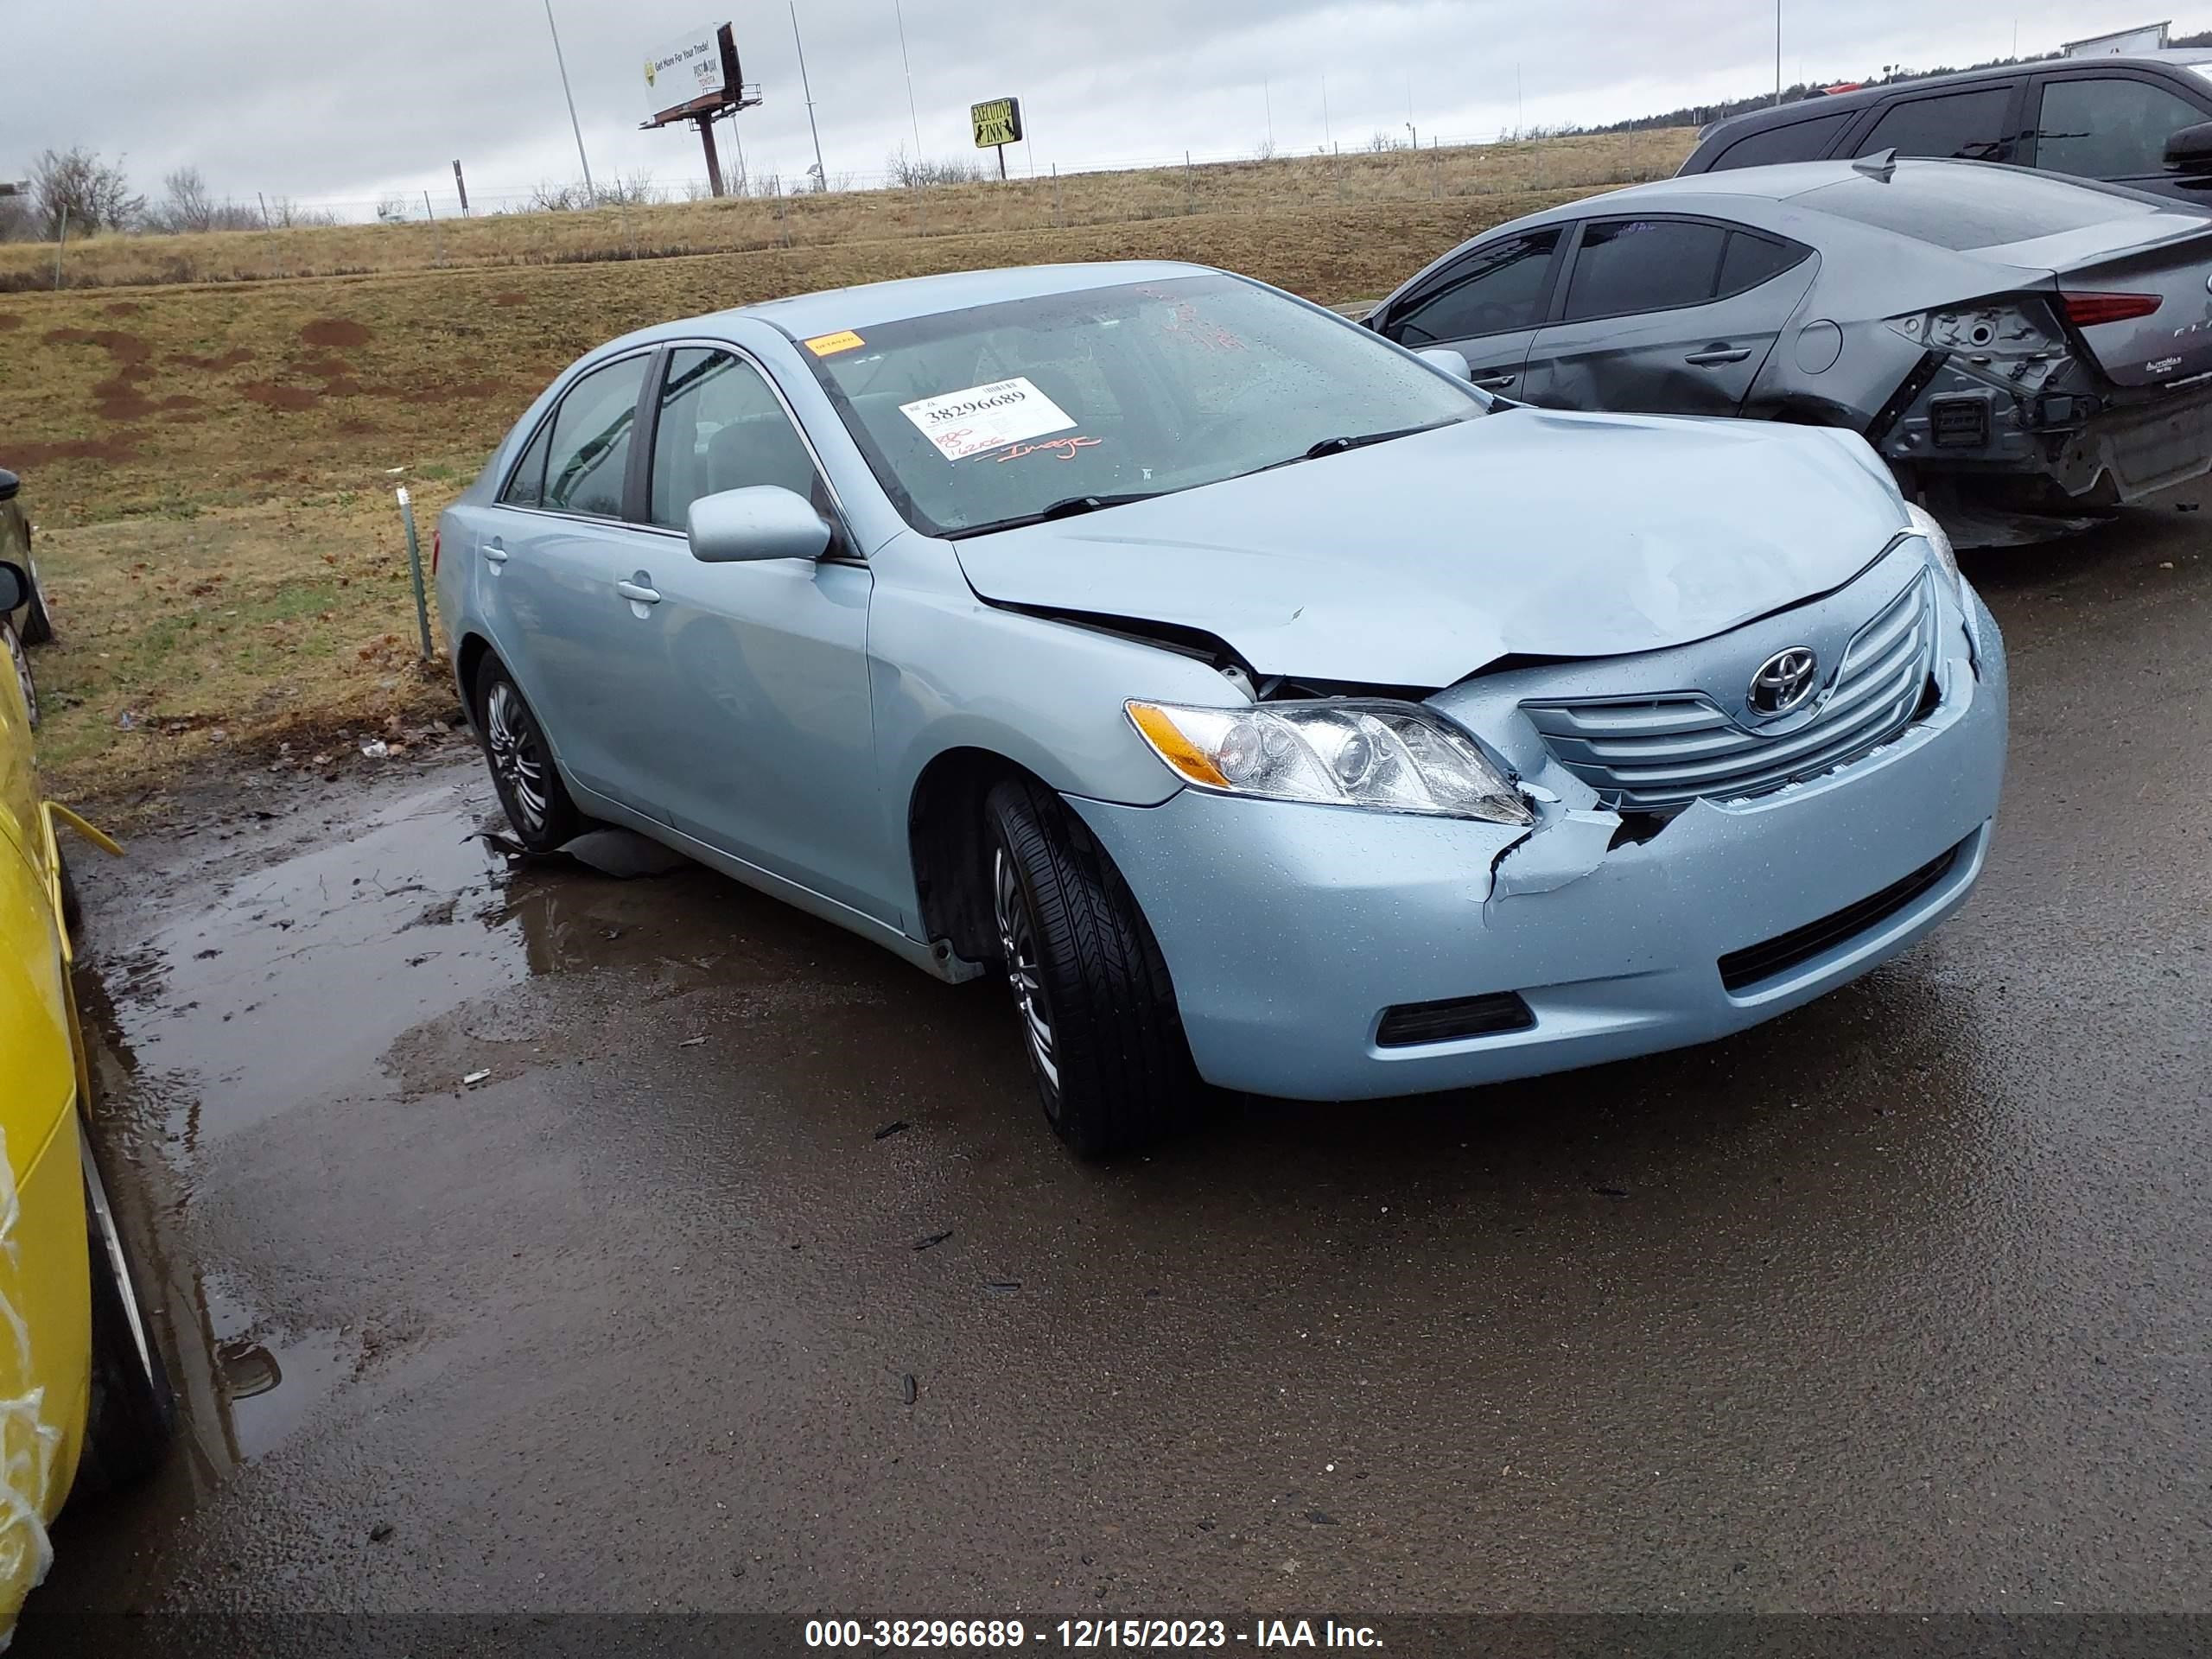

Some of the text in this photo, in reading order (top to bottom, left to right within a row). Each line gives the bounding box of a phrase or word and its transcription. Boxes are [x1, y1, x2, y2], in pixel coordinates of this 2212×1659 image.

[654, 61, 664, 72] Get
[663, 57, 675, 68] More
[674, 54, 683, 63] For
[683, 48, 694, 60] Your
[698, 76, 715, 86] TOYOTA
[972, 99, 1011, 123] EXECUTIVE
[986, 122, 1002, 143] INN
[925, 391, 1026, 423] 38296689
